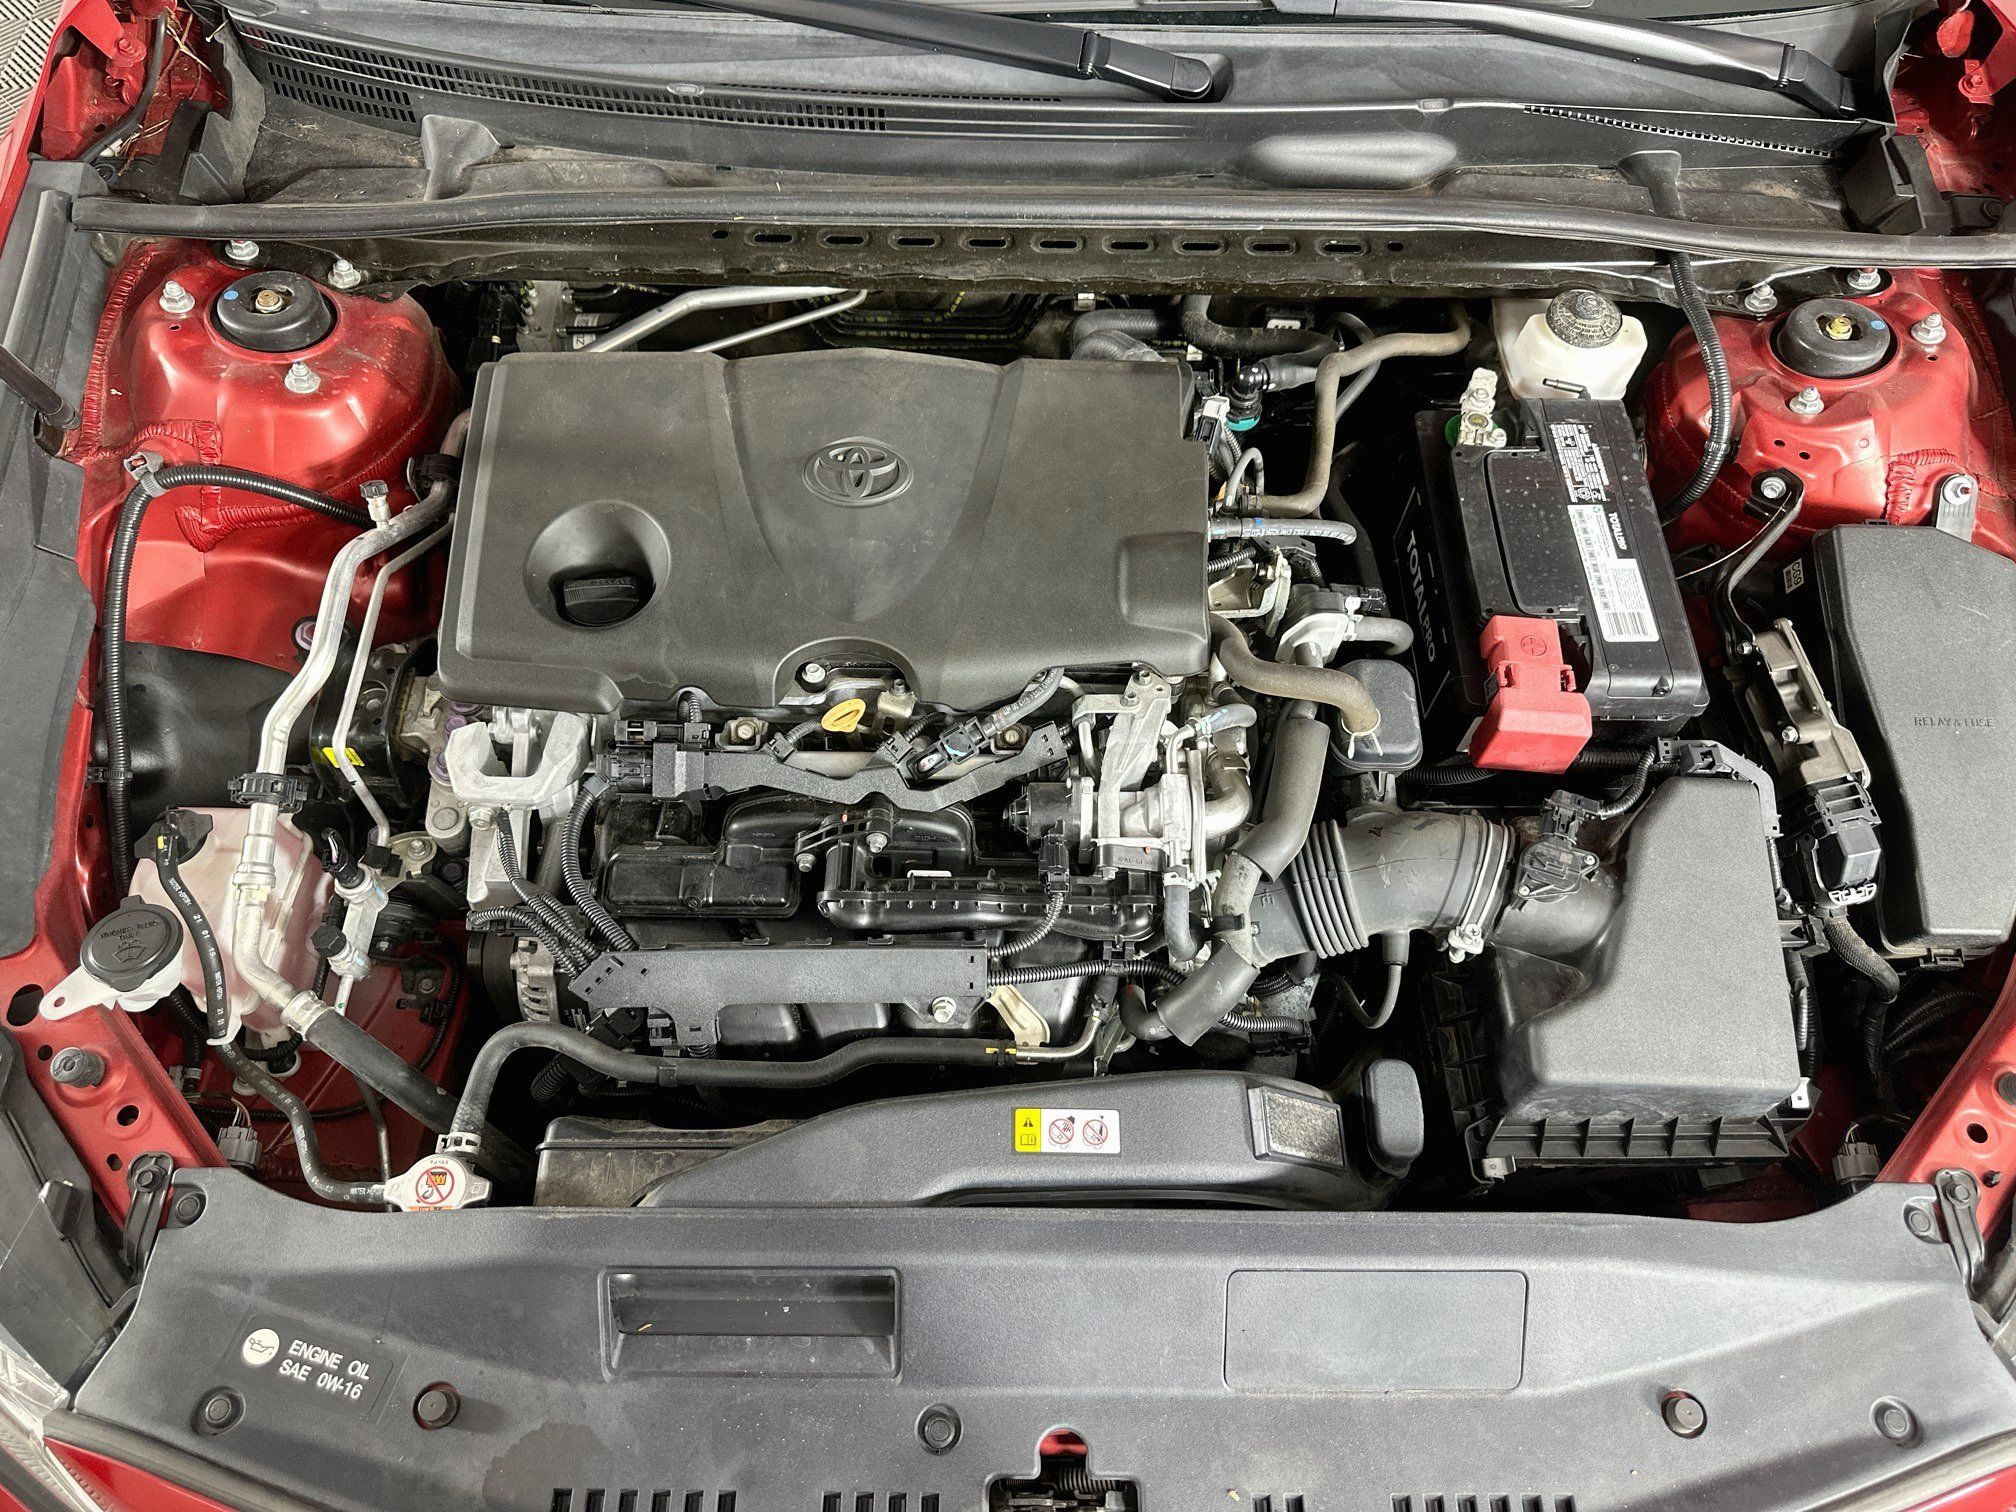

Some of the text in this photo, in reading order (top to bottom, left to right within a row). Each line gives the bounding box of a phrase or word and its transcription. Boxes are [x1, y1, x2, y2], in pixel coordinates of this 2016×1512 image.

[1791, 561, 1802, 586] CG9
[1406, 529, 1436, 663] TOTALPRO
[1914, 716, 1951, 727] RELAY
[201, 929, 211, 940] 01
[288, 1339, 370, 1381] ENGINE OIL
[278, 1358, 364, 1400] SAE 0W-16
